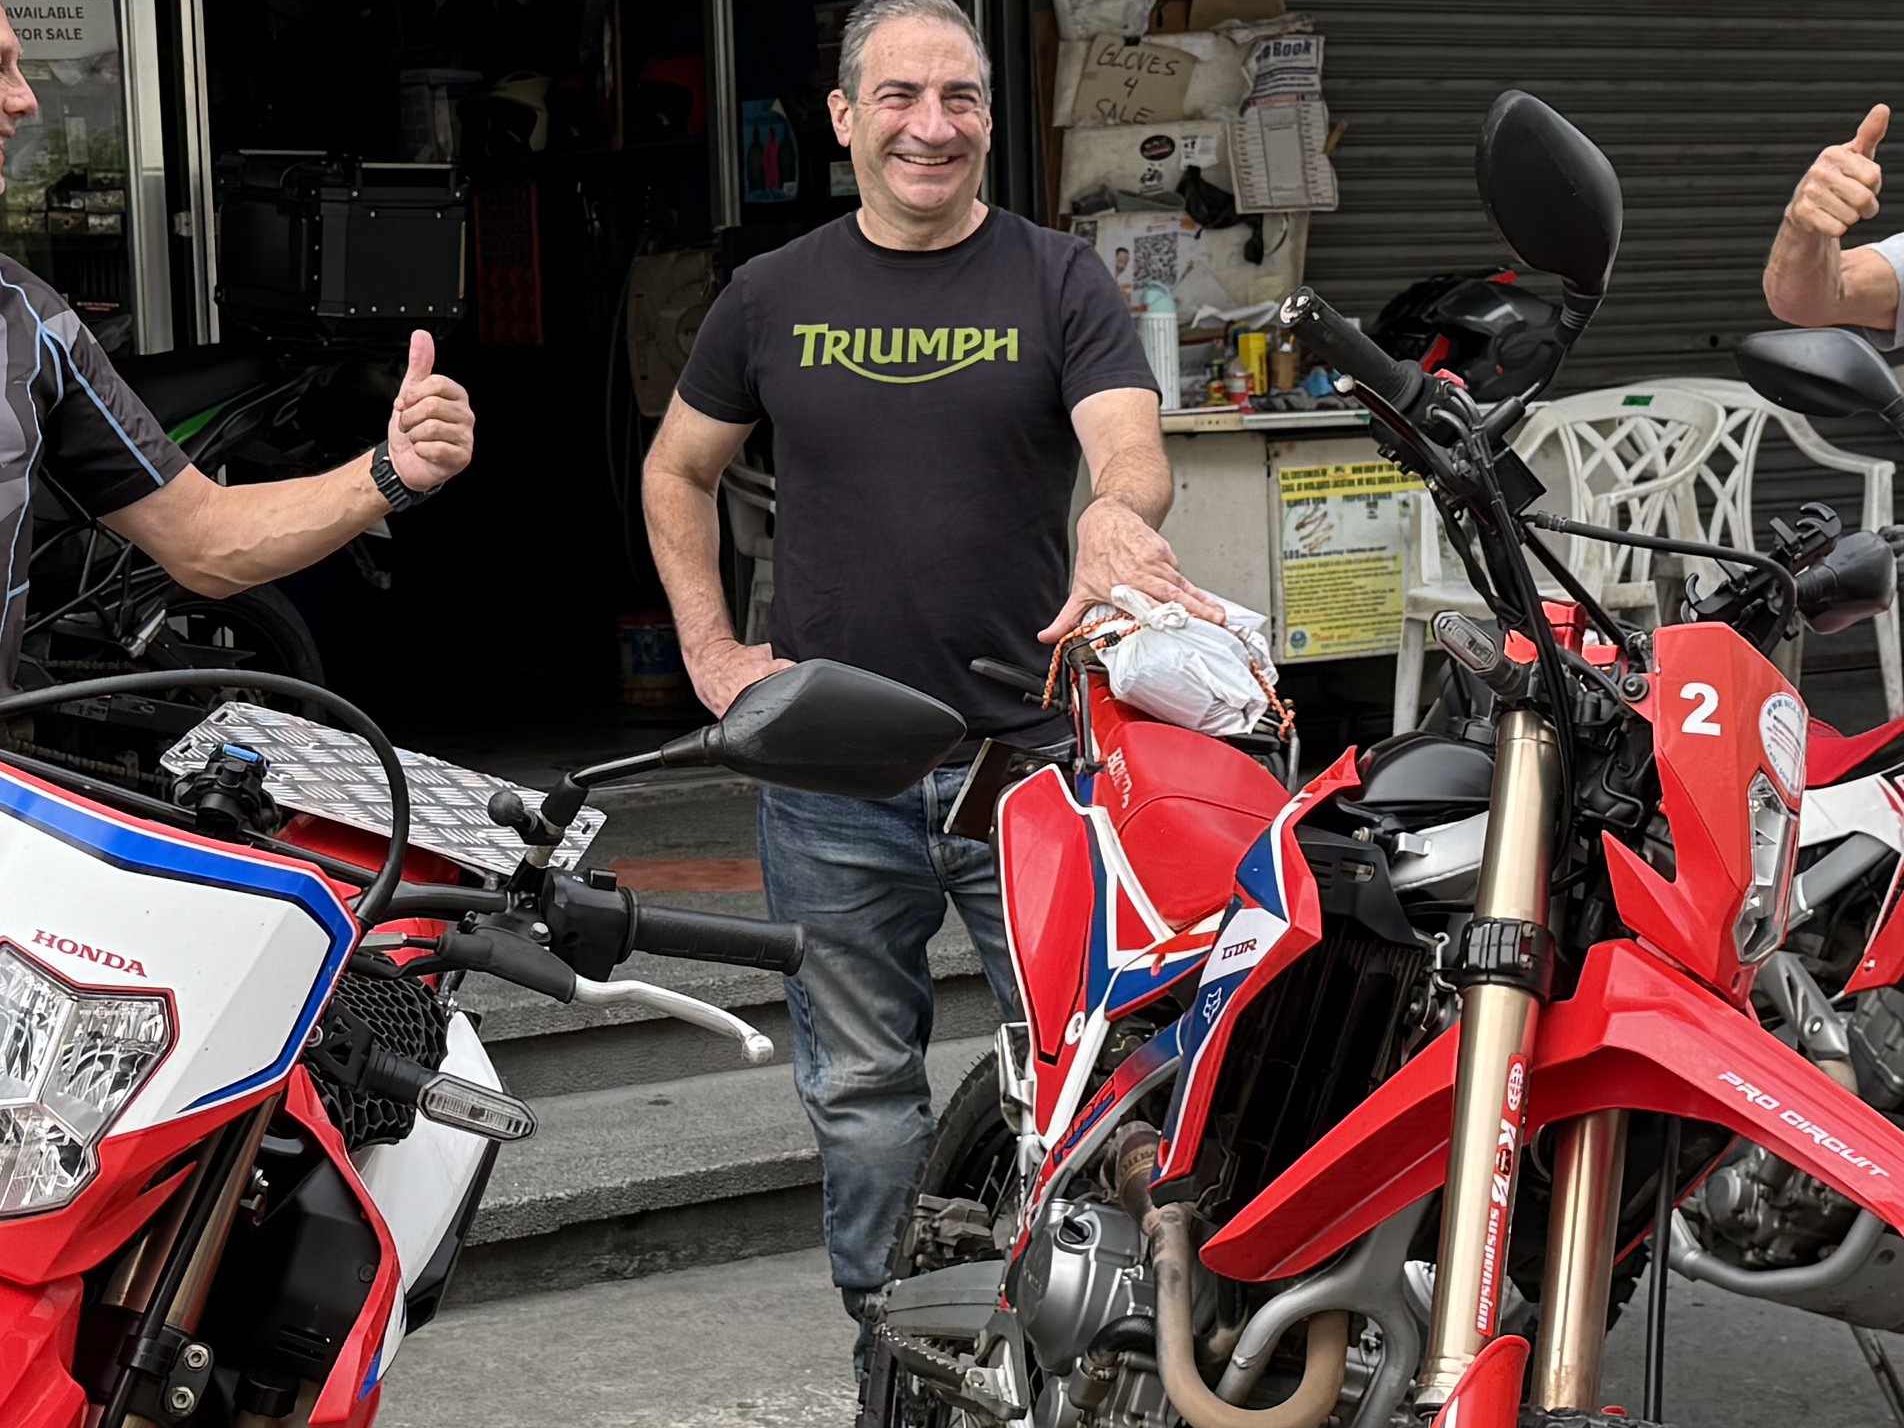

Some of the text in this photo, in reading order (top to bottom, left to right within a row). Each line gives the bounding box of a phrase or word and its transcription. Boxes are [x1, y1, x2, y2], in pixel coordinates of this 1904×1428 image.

[6, 6, 85, 20] AVAILABLE
[45, 27, 84, 41] SALE
[1095, 43, 1181, 77] GLOVES
[1124, 77, 1138, 99] 4
[1095, 98, 1156, 124] SALE
[792, 322, 1020, 378] TRIUMPH
[1678, 681, 1722, 737] 2
[31, 928, 148, 979] HONDA
[1717, 1069, 1890, 1181] PRO CIRCUIT
